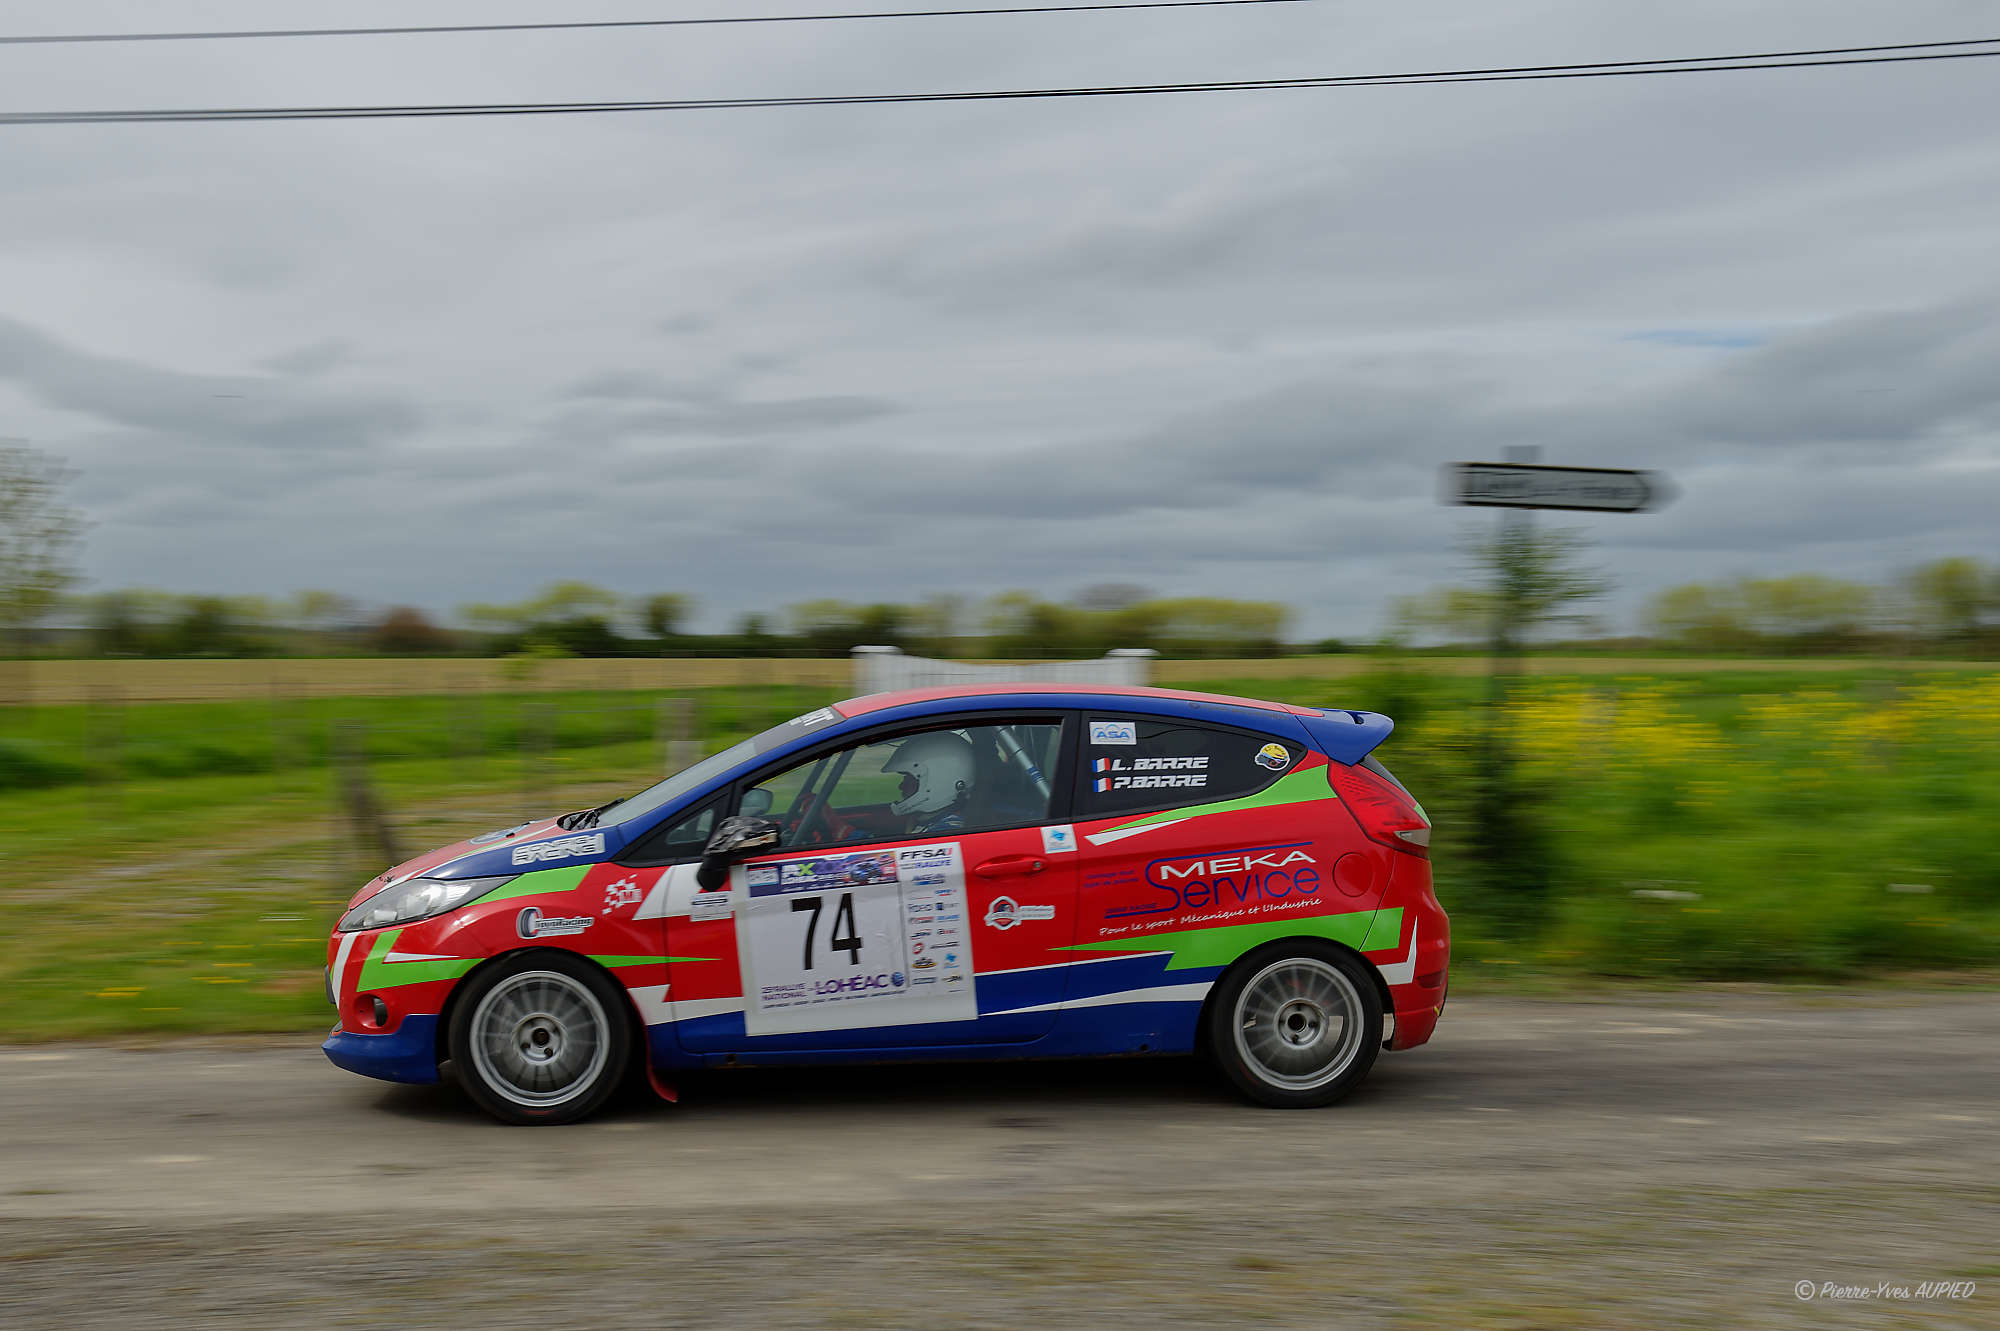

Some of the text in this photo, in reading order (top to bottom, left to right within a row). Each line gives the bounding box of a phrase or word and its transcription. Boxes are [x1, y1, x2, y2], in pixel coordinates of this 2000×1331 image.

[1096, 731, 1130, 739] ASA
[1113, 774, 1208, 789] P.BARRE
[900, 848, 946, 860] FFSA
[1160, 850, 1317, 880] MEKA
[1145, 857, 1320, 912] Service
[790, 892, 863, 970] 74
[1099, 927, 1129, 936] Pour
[1131, 922, 1144, 931] le
[1145, 917, 1176, 930] sport
[1180, 909, 1246, 925] Mécanique
[1247, 905, 1261, 915] et
[814, 974, 889, 996] LOHÉAC
